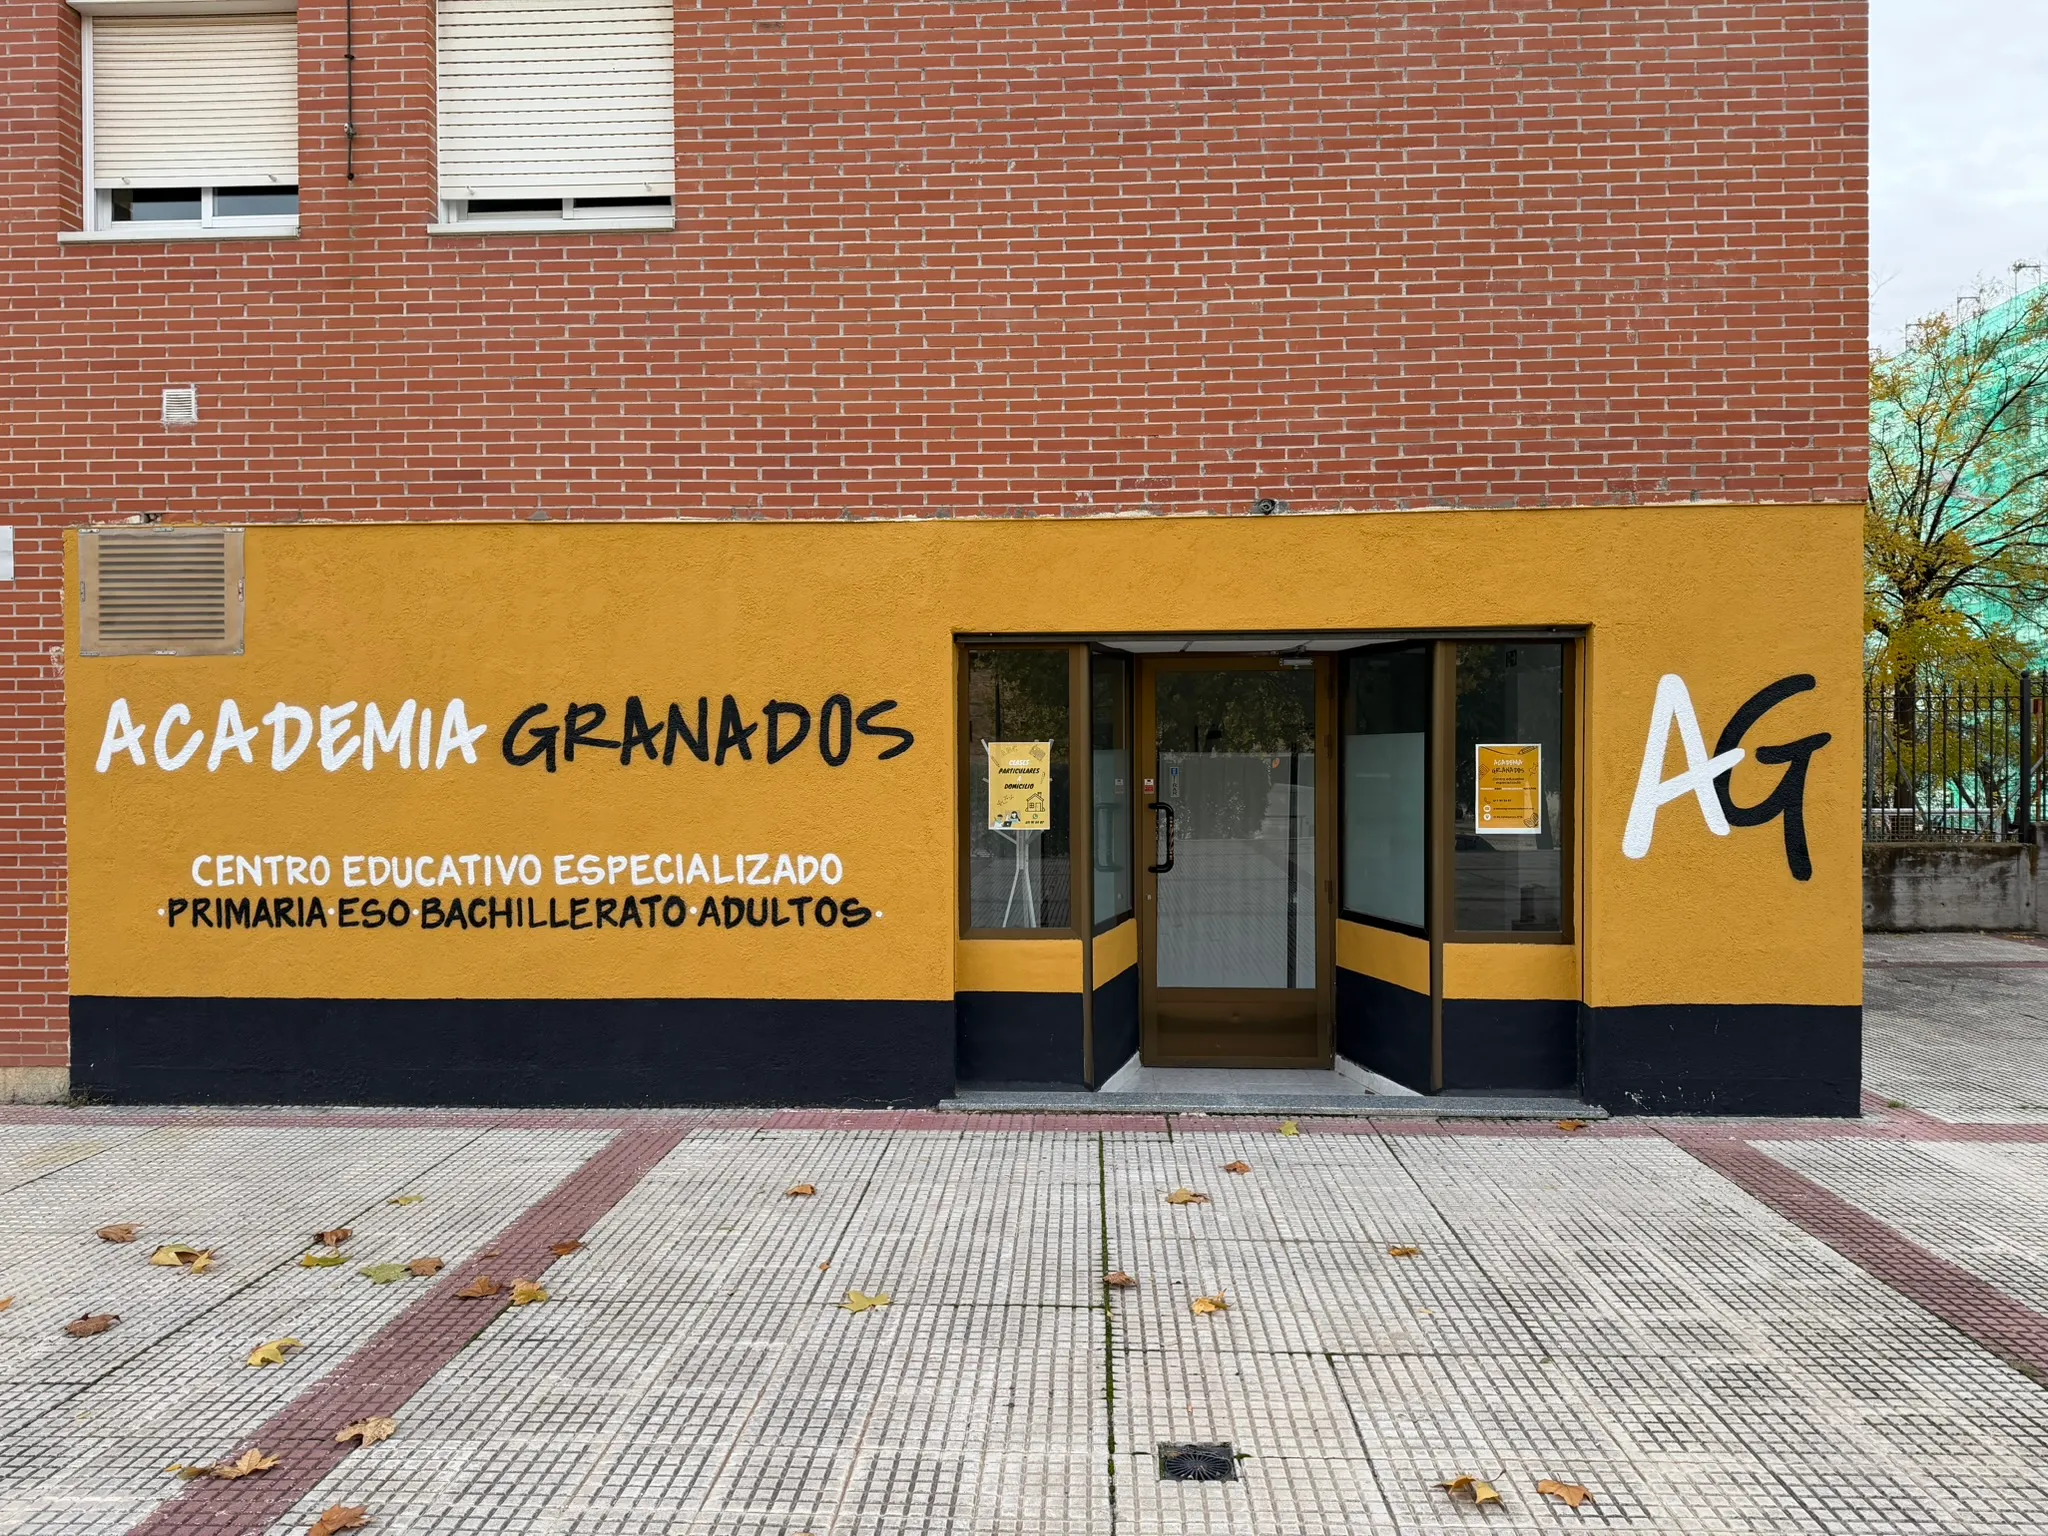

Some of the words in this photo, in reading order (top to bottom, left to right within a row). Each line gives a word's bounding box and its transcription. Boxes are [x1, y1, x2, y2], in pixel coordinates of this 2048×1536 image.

[95, 698, 488, 774] ACADEMIA
[502, 693, 915, 773] GRANADOS
[1622, 673, 1832, 882] AG
[191, 855, 331, 887] CENTRO
[342, 854, 542, 889] EDUCATIVO
[553, 853, 844, 887] ESPECIALIZADO
